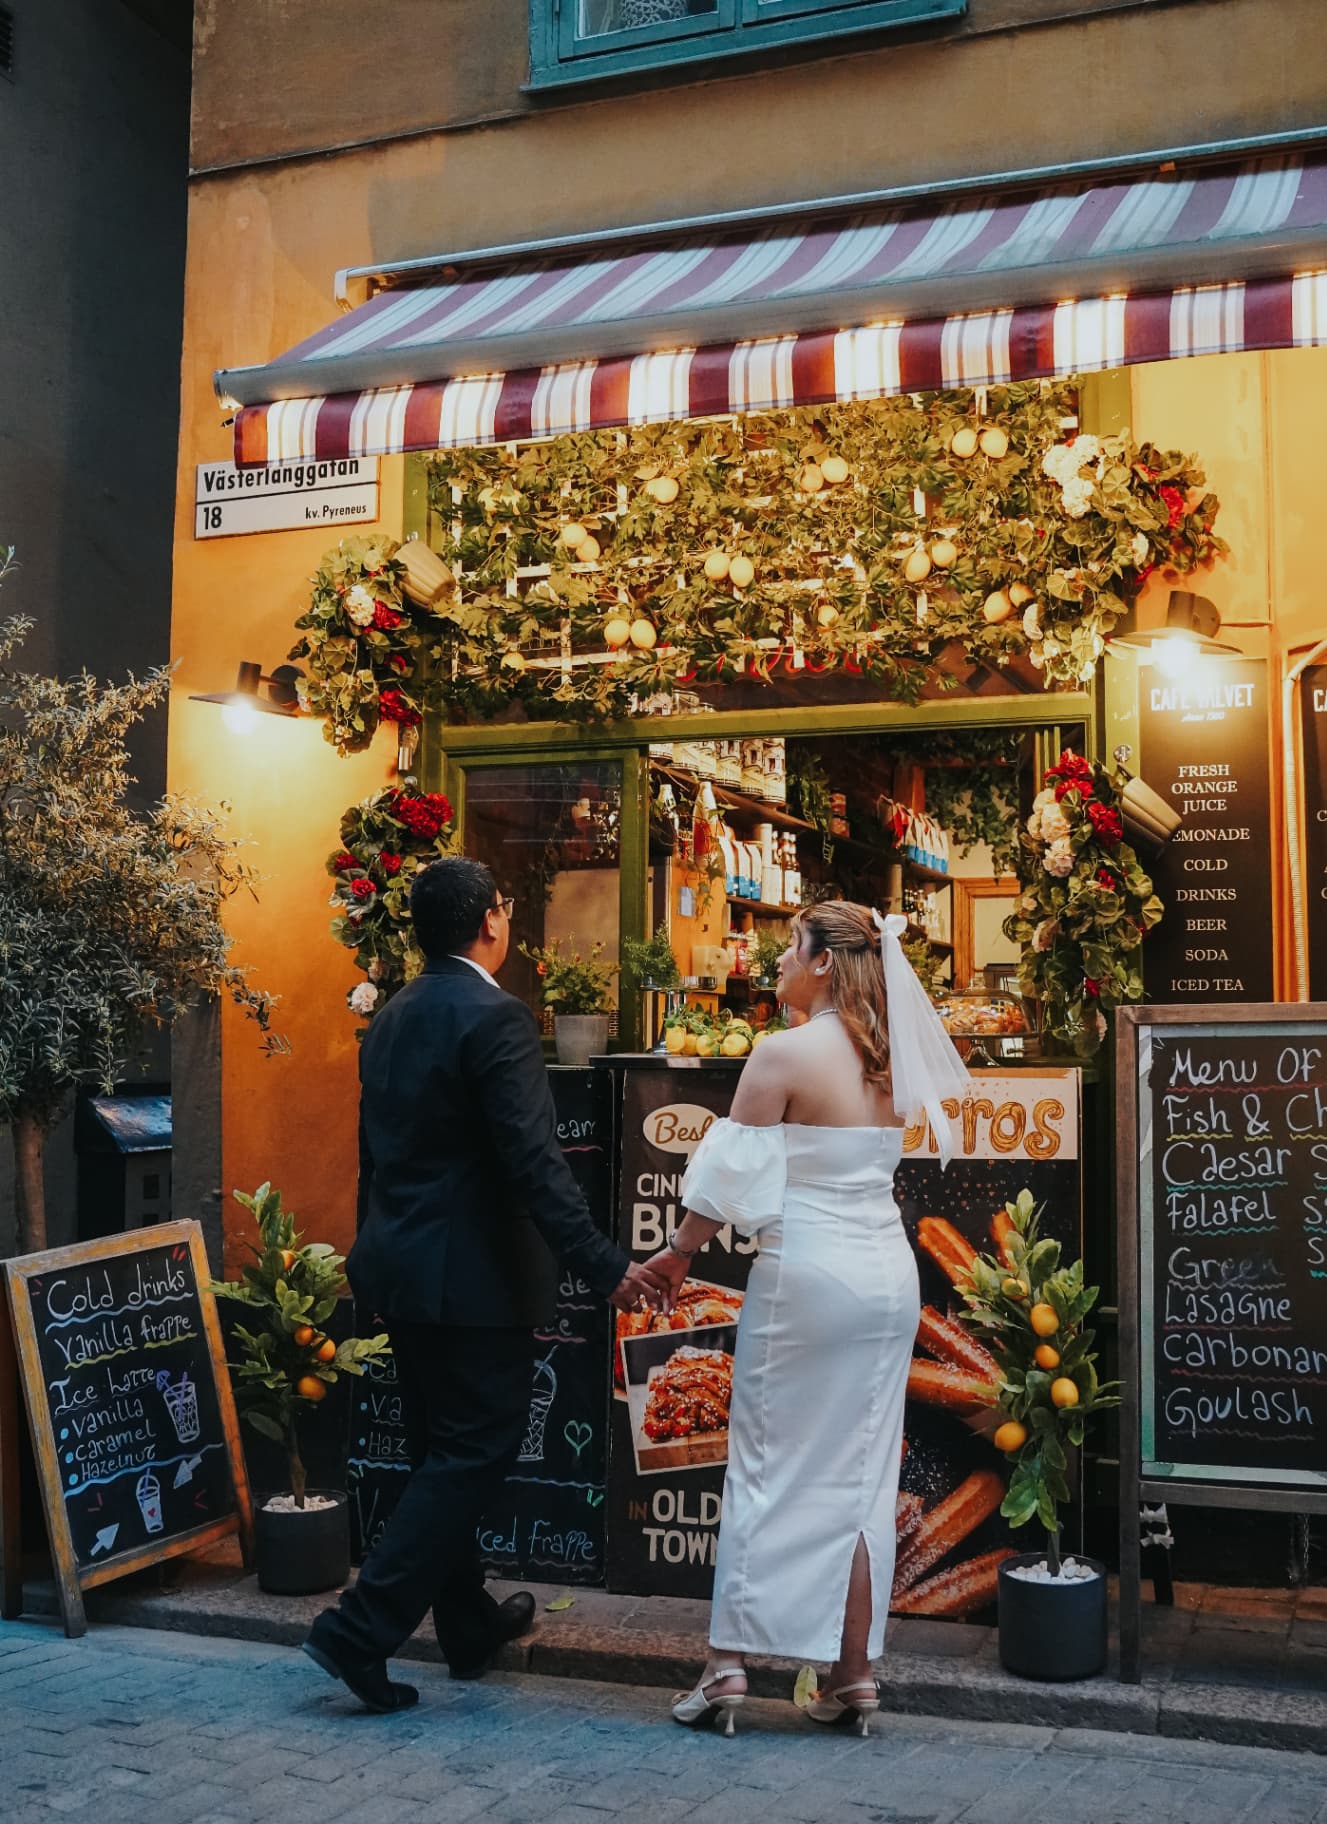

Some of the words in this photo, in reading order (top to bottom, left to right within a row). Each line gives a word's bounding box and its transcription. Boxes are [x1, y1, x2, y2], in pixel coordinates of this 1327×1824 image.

[203, 506, 222, 530] 18
[305, 507, 320, 520] kv.
[323, 504, 366, 520] Pyreneus
[1178, 764, 1230, 778] FRESH
[1171, 780, 1238, 795] ORANGE
[1182, 799, 1228, 815] JUICE
[1172, 828, 1250, 842] EMONADE
[1183, 859, 1228, 871] COLD
[1176, 888, 1237, 902] DRINKS
[1186, 919, 1228, 931] BEER
[1185, 949, 1228, 961] SODA
[1171, 979, 1210, 991] ICED
[1212, 978, 1245, 991] TEA
[1169, 1048, 1257, 1087] Menu
[1162, 1095, 1232, 1134] Fish
[1242, 1093, 1270, 1135] &
[1286, 1087, 1327, 1132] Ch
[1162, 1141, 1292, 1186] Caesar
[1166, 1190, 1276, 1230] Falafel
[47, 1270, 114, 1320] Cold
[128, 1258, 186, 1306] drinks
[1165, 1386, 1313, 1439] Goulash
[628, 1500, 648, 1521] IN
[652, 1488, 722, 1526] OLD
